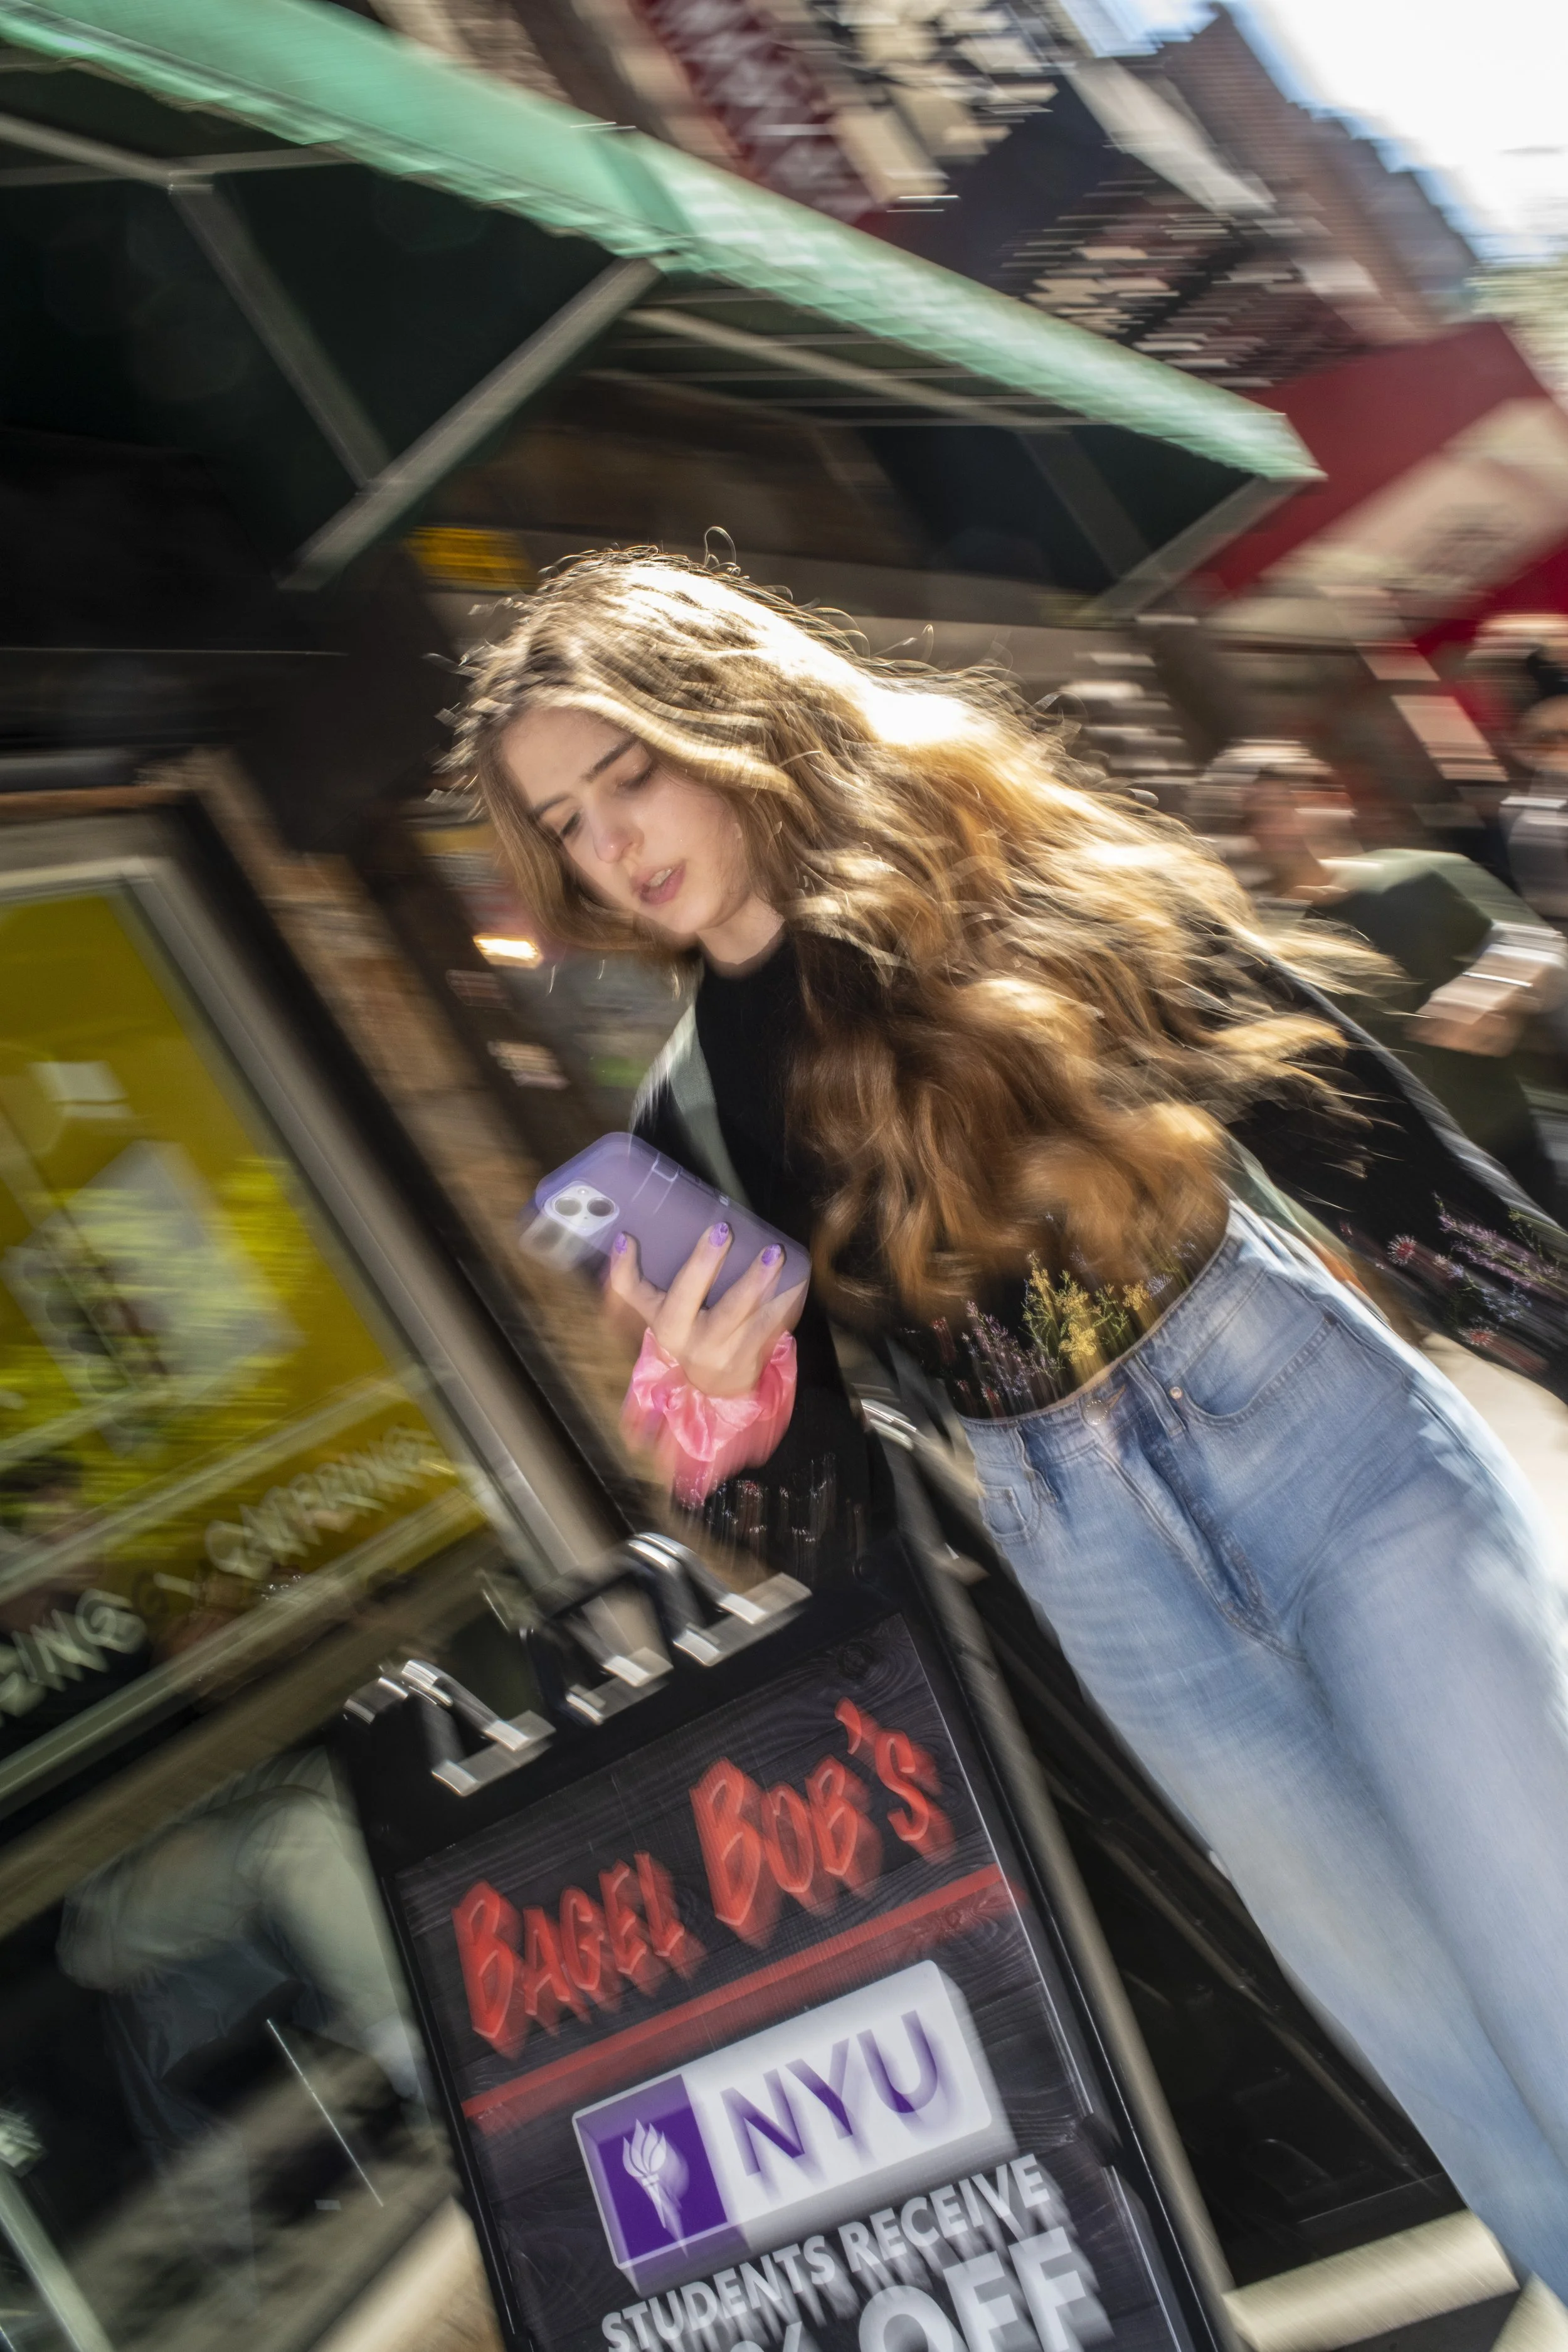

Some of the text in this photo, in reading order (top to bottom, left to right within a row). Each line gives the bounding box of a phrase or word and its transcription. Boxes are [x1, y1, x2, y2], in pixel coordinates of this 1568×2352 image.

[719, 2010, 944, 2180] NYU
[601, 2154, 1054, 2352] STUDENTS RECEIVE
[858, 2226, 1098, 2352] OFF
